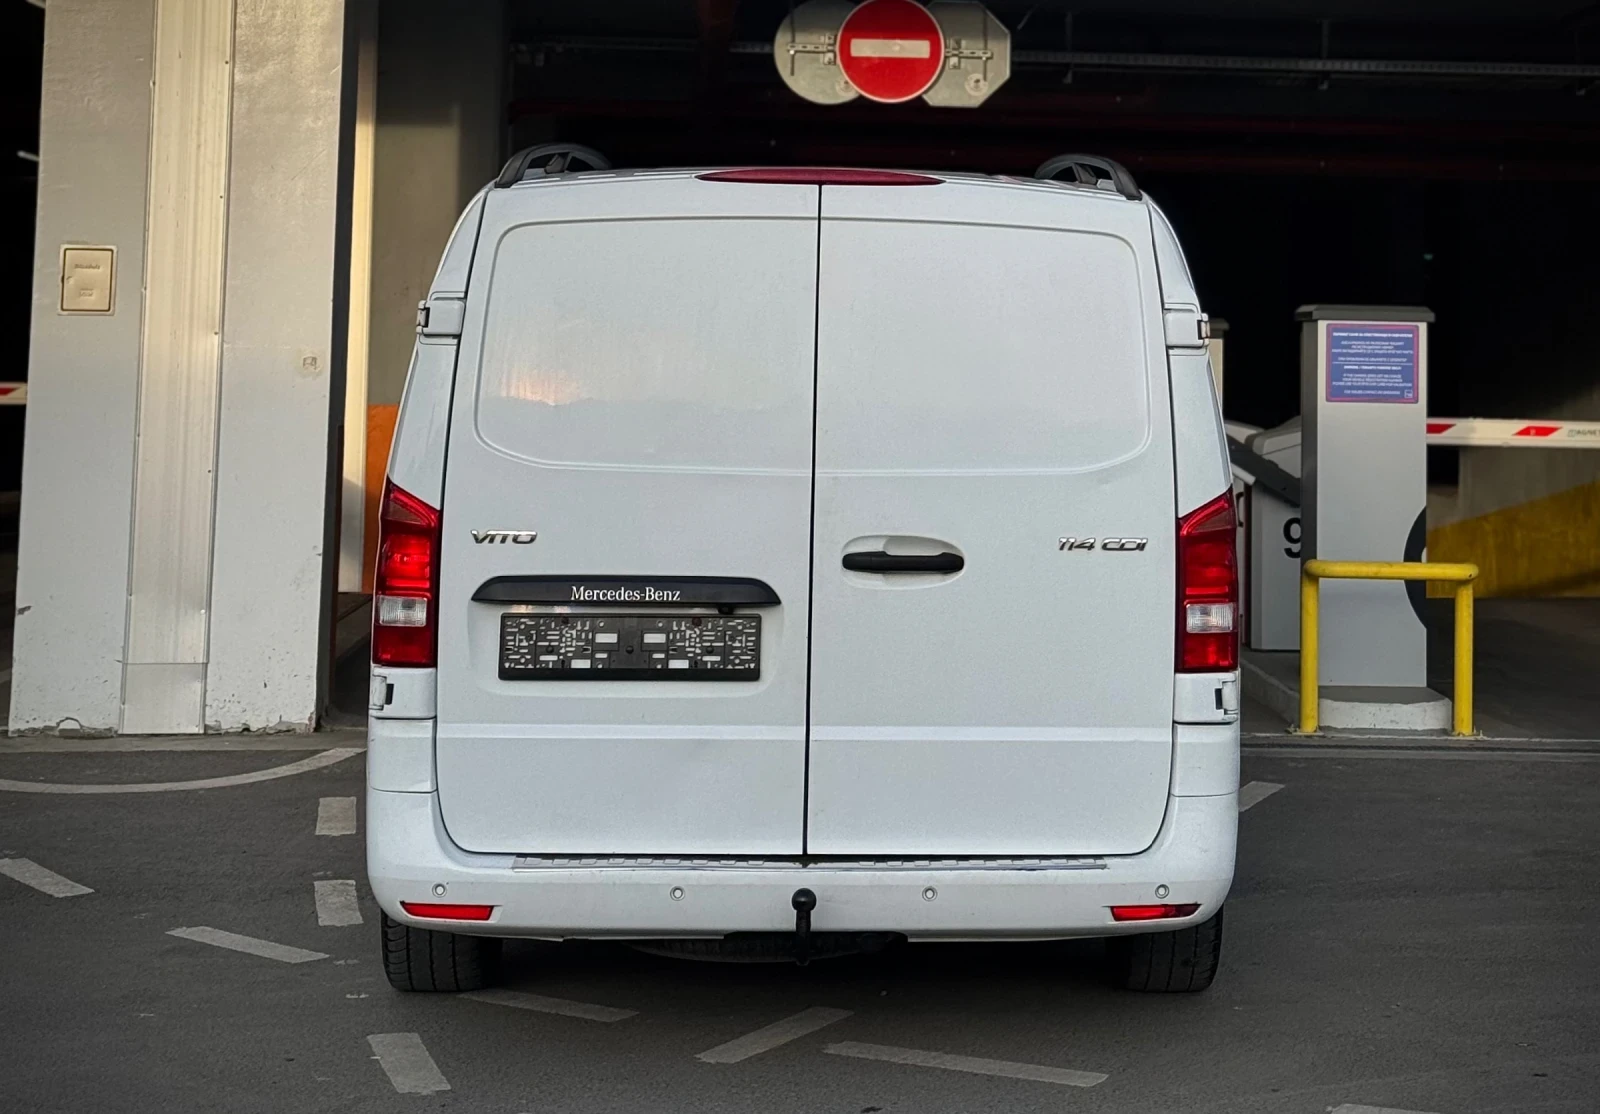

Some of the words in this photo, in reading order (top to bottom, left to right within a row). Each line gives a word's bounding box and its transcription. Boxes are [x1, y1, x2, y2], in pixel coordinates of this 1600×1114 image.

[471, 530, 537, 544] VITO
[1059, 538, 1096, 551] 114
[1101, 538, 1148, 551] CDI
[570, 585, 681, 601] Mercedes-Benz
